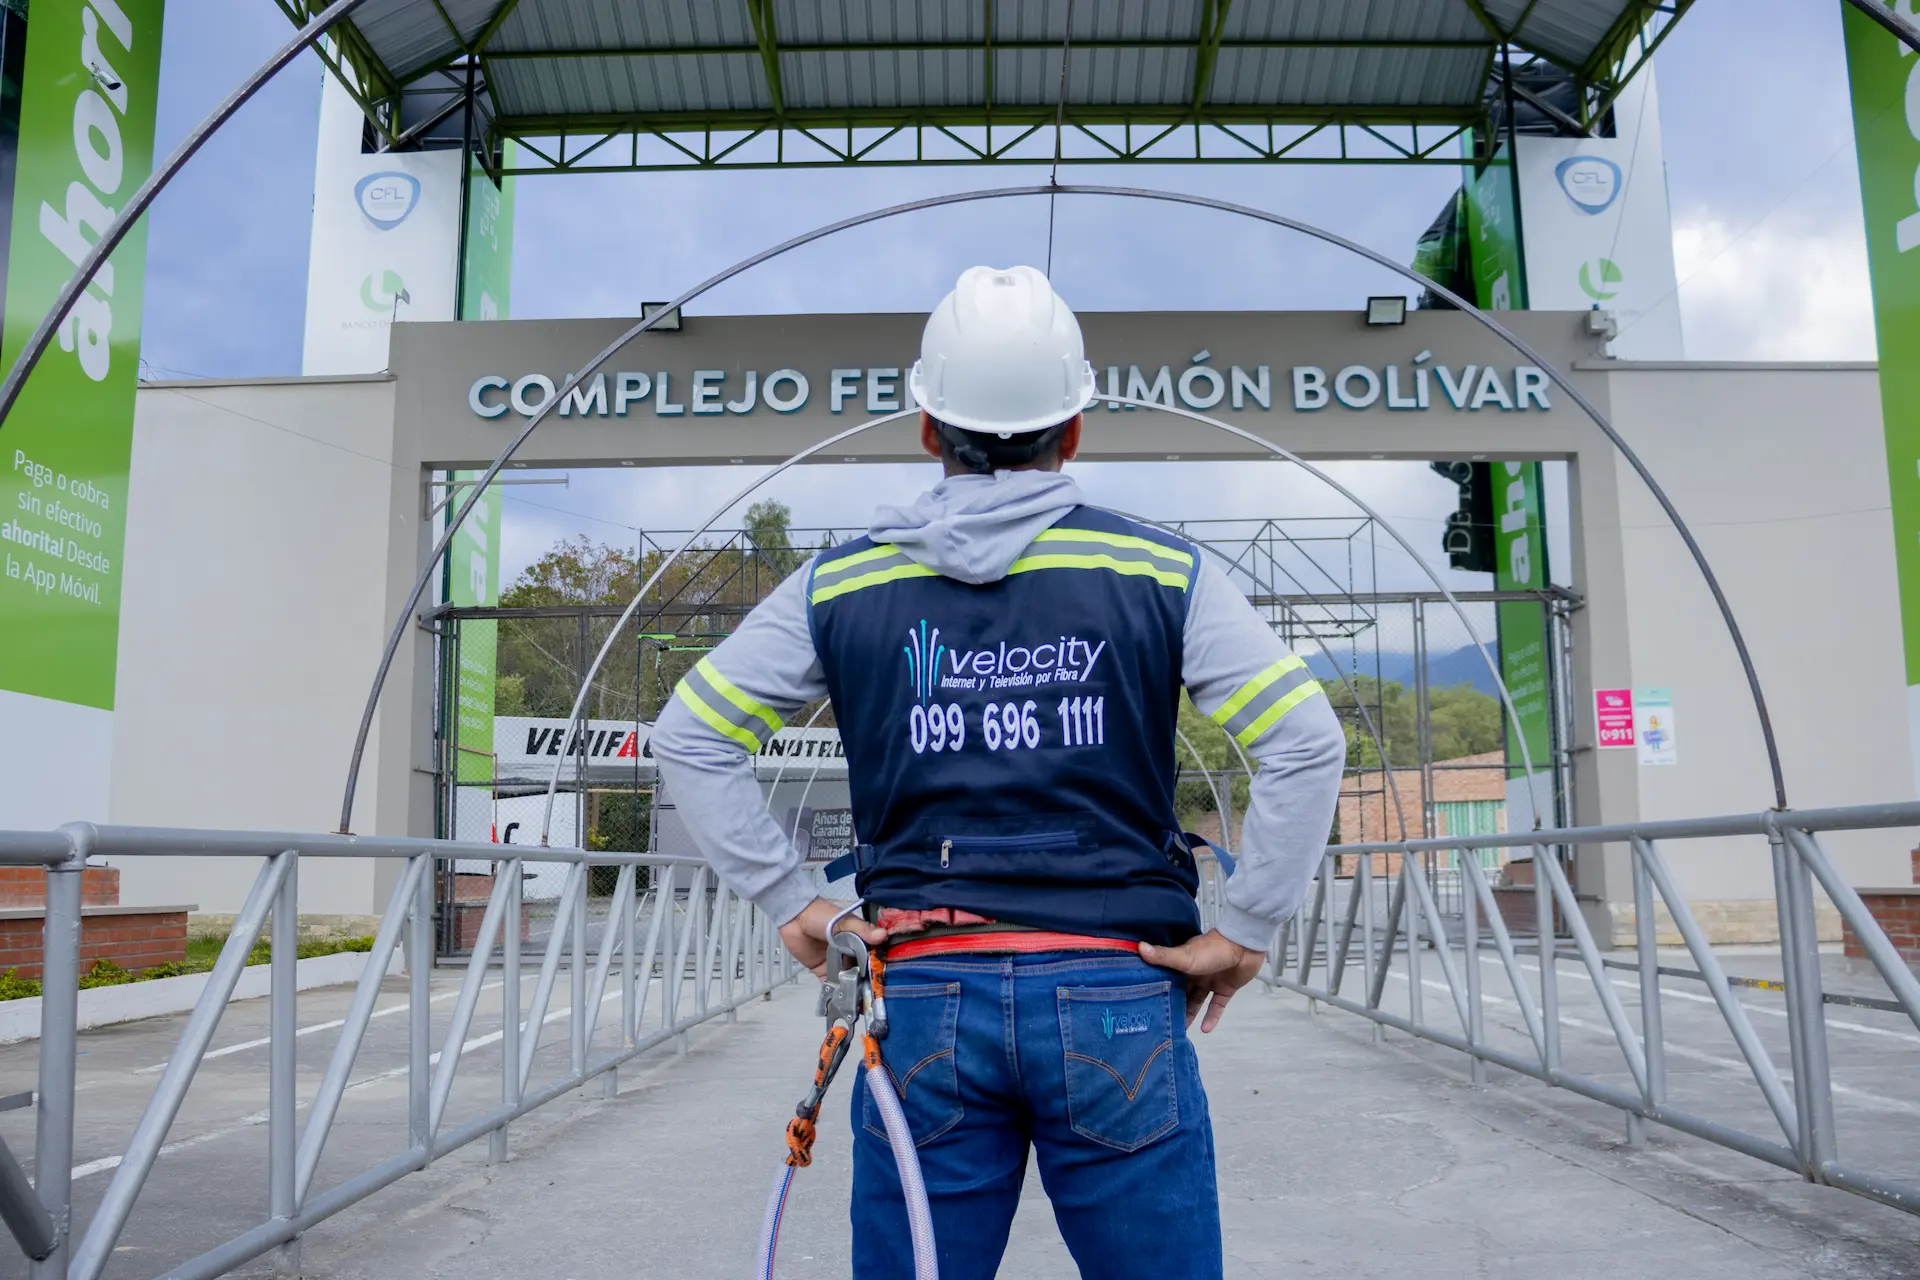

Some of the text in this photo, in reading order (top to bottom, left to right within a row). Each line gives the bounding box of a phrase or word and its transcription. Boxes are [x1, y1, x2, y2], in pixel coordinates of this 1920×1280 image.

[370, 187, 404, 200] CFL
[468, 349, 1552, 418] COMPLEJO FE IMÓN BOLÍVAR
[14, 449, 109, 510] Paga o cobra
[18, 491, 101, 539] sin efectivo
[1, 518, 110, 574] ahorita! Desde
[5, 552, 102, 606] la App Móvil.
[941, 667, 1078, 691] Internet y Televisión por Fibra
[949, 635, 1106, 682] velocity
[909, 696, 1104, 754] 099 696 1111
[813, 811, 852, 825] Años de
